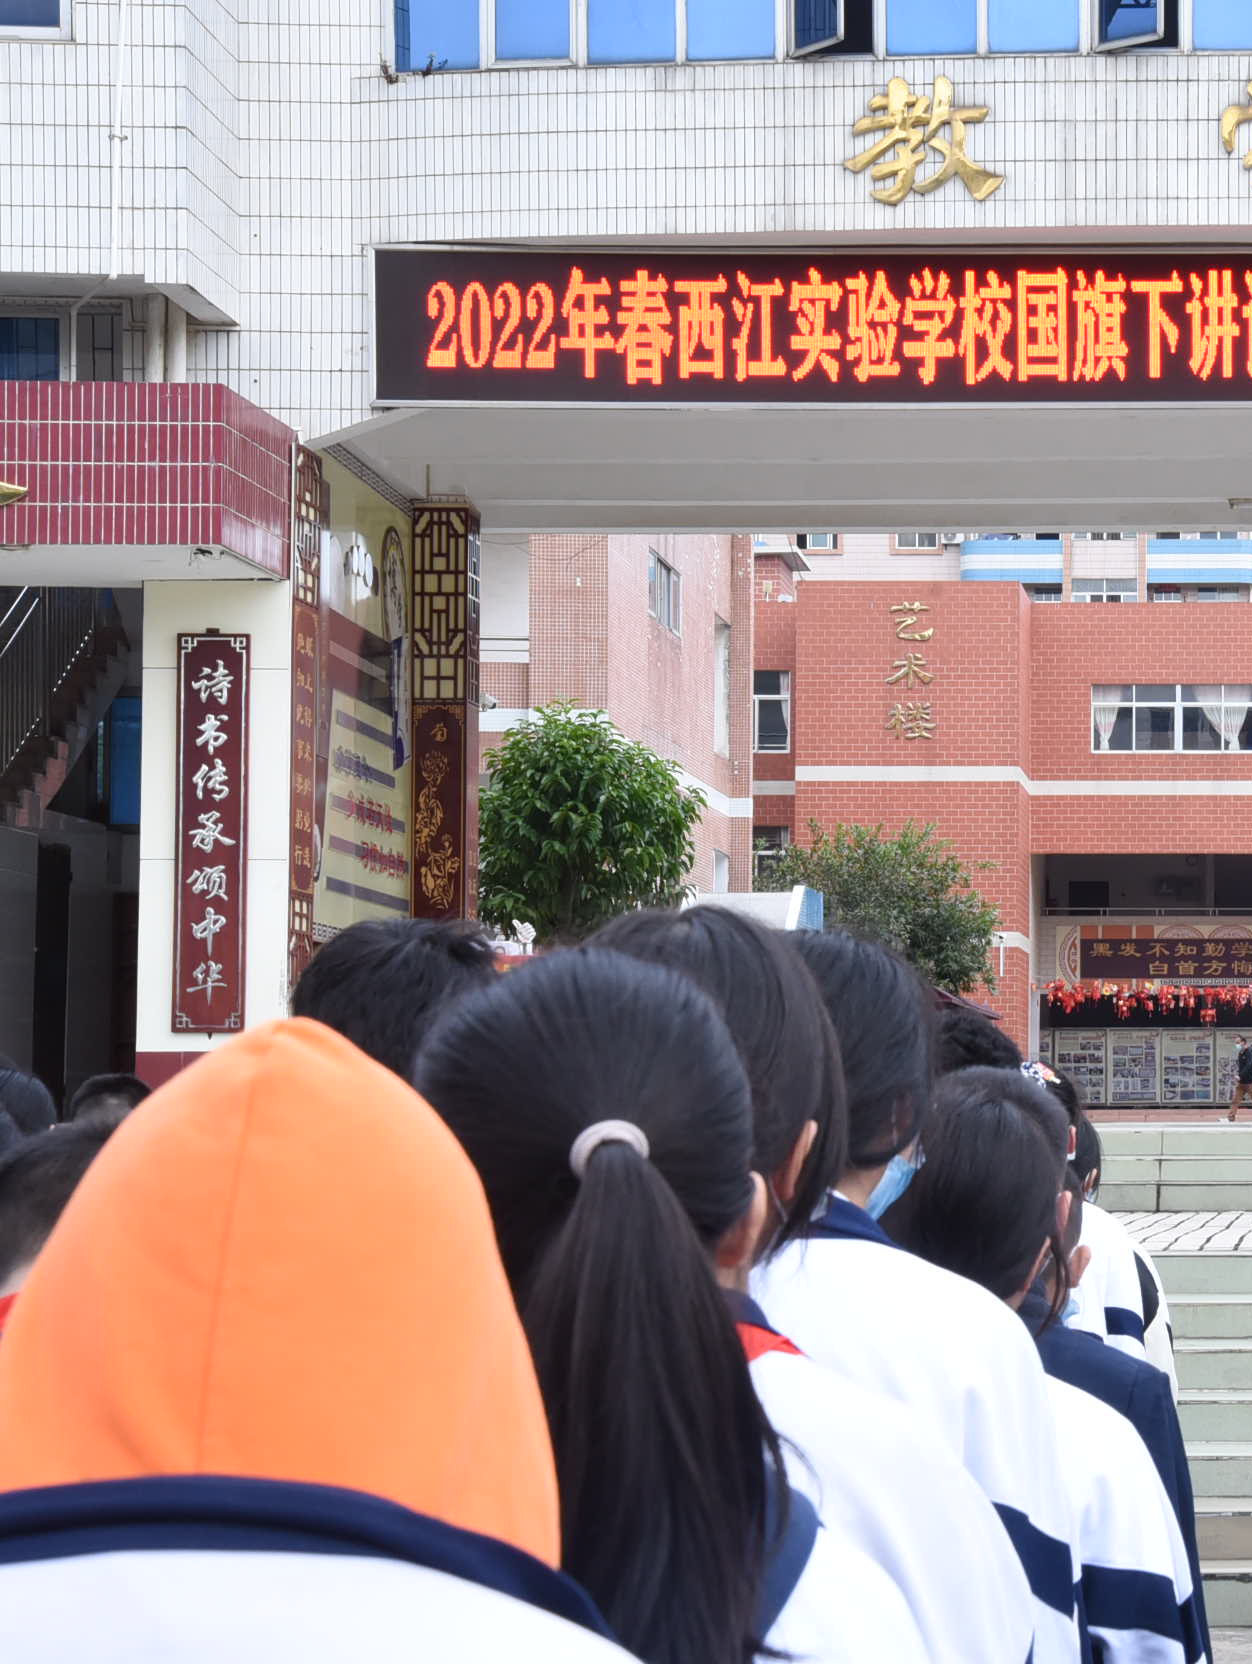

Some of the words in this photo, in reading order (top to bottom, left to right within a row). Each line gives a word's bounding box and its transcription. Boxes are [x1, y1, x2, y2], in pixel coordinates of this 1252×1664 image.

[885, 600, 937, 741] 艺术楼
[186, 659, 236, 1006] 诗书传承颂中华
